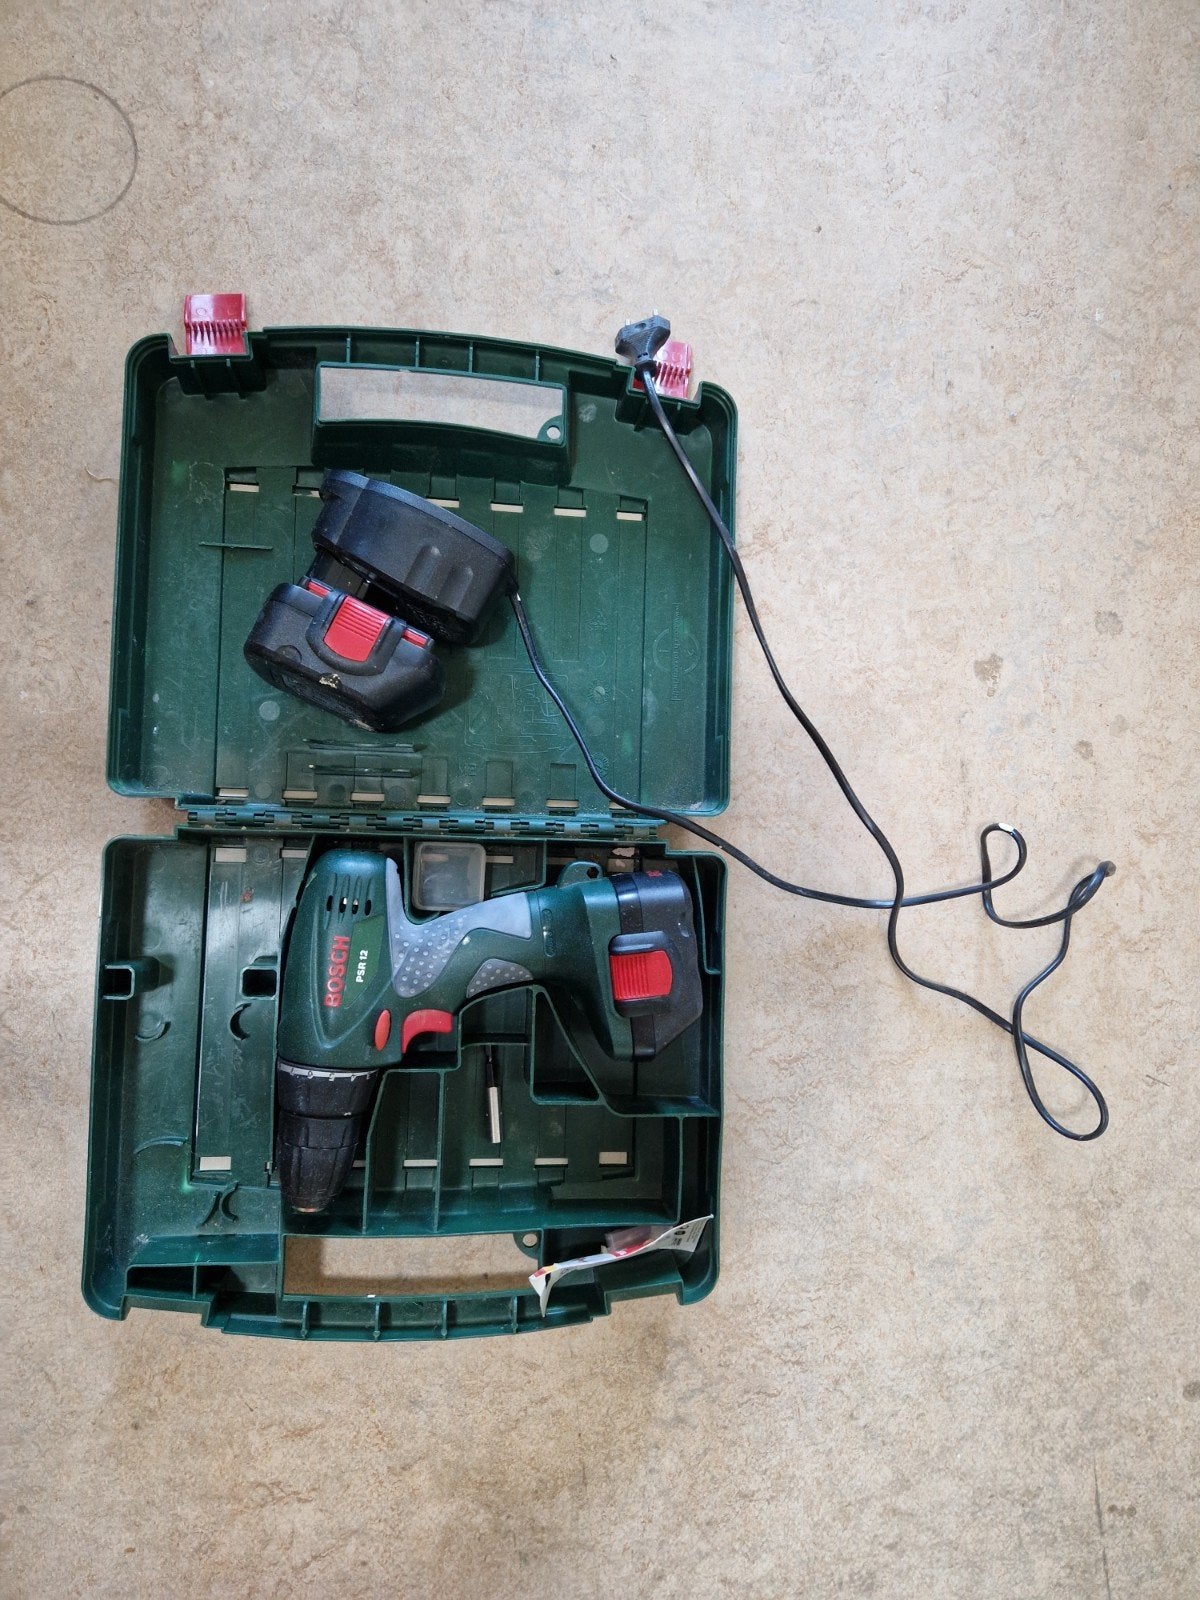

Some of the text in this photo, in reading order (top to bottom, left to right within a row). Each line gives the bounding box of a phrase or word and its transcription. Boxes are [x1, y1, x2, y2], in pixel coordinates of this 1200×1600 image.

[324, 934, 350, 1007] BOSCH
[355, 949, 369, 983] PSR 12
